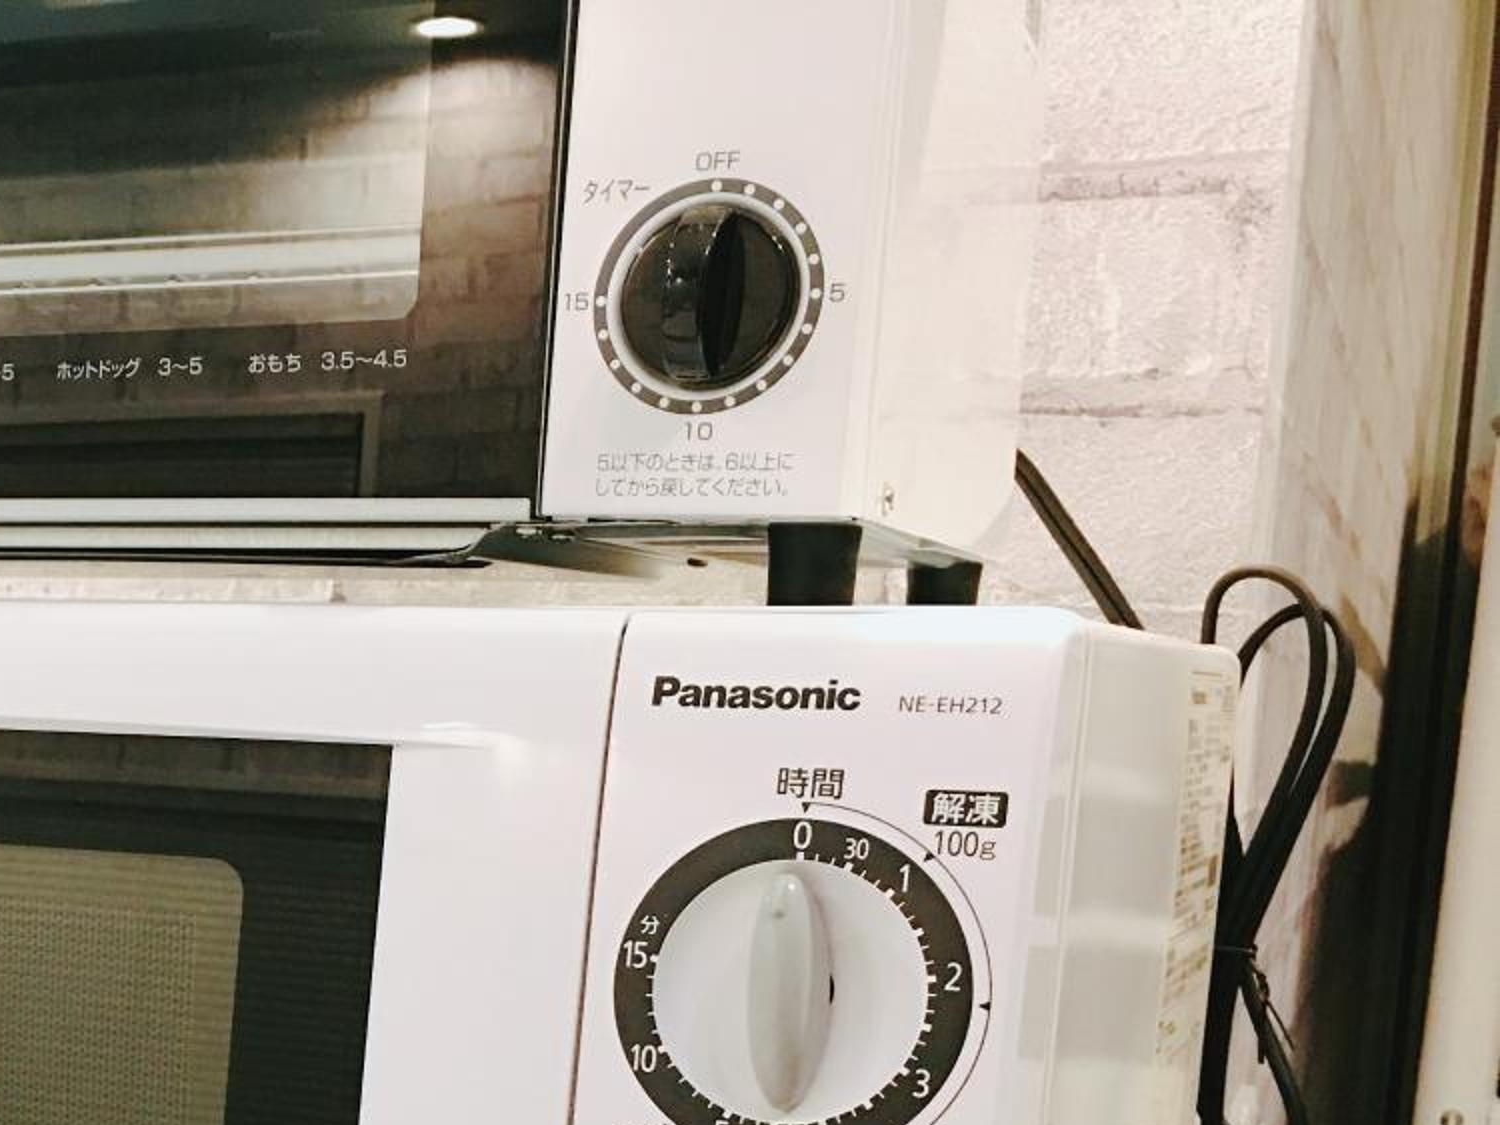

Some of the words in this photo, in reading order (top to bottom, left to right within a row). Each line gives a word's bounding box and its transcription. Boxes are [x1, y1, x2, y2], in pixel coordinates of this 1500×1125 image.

[696, 151, 740, 171] OFF
[582, 179, 651, 204] タイマー
[564, 292, 589, 311] 15
[830, 283, 845, 302] 5
[57, 359, 140, 380] ホットドッグ
[249, 353, 302, 373] おもち
[684, 422, 712, 441] 10
[651, 676, 861, 711] Panasonic
[898, 696, 1002, 714] NE-EH212
[776, 768, 844, 799] 時間
[931, 794, 1001, 825] 解凍
[793, 822, 811, 849] 0
[934, 831, 996, 860] 100g
[845, 838, 870, 860] 30
[899, 864, 909, 889] 1
[640, 916, 660, 934] 分
[624, 941, 648, 968] 15
[945, 963, 962, 991] 2
[631, 1044, 656, 1071] 10
[912, 1070, 930, 1098] 3
